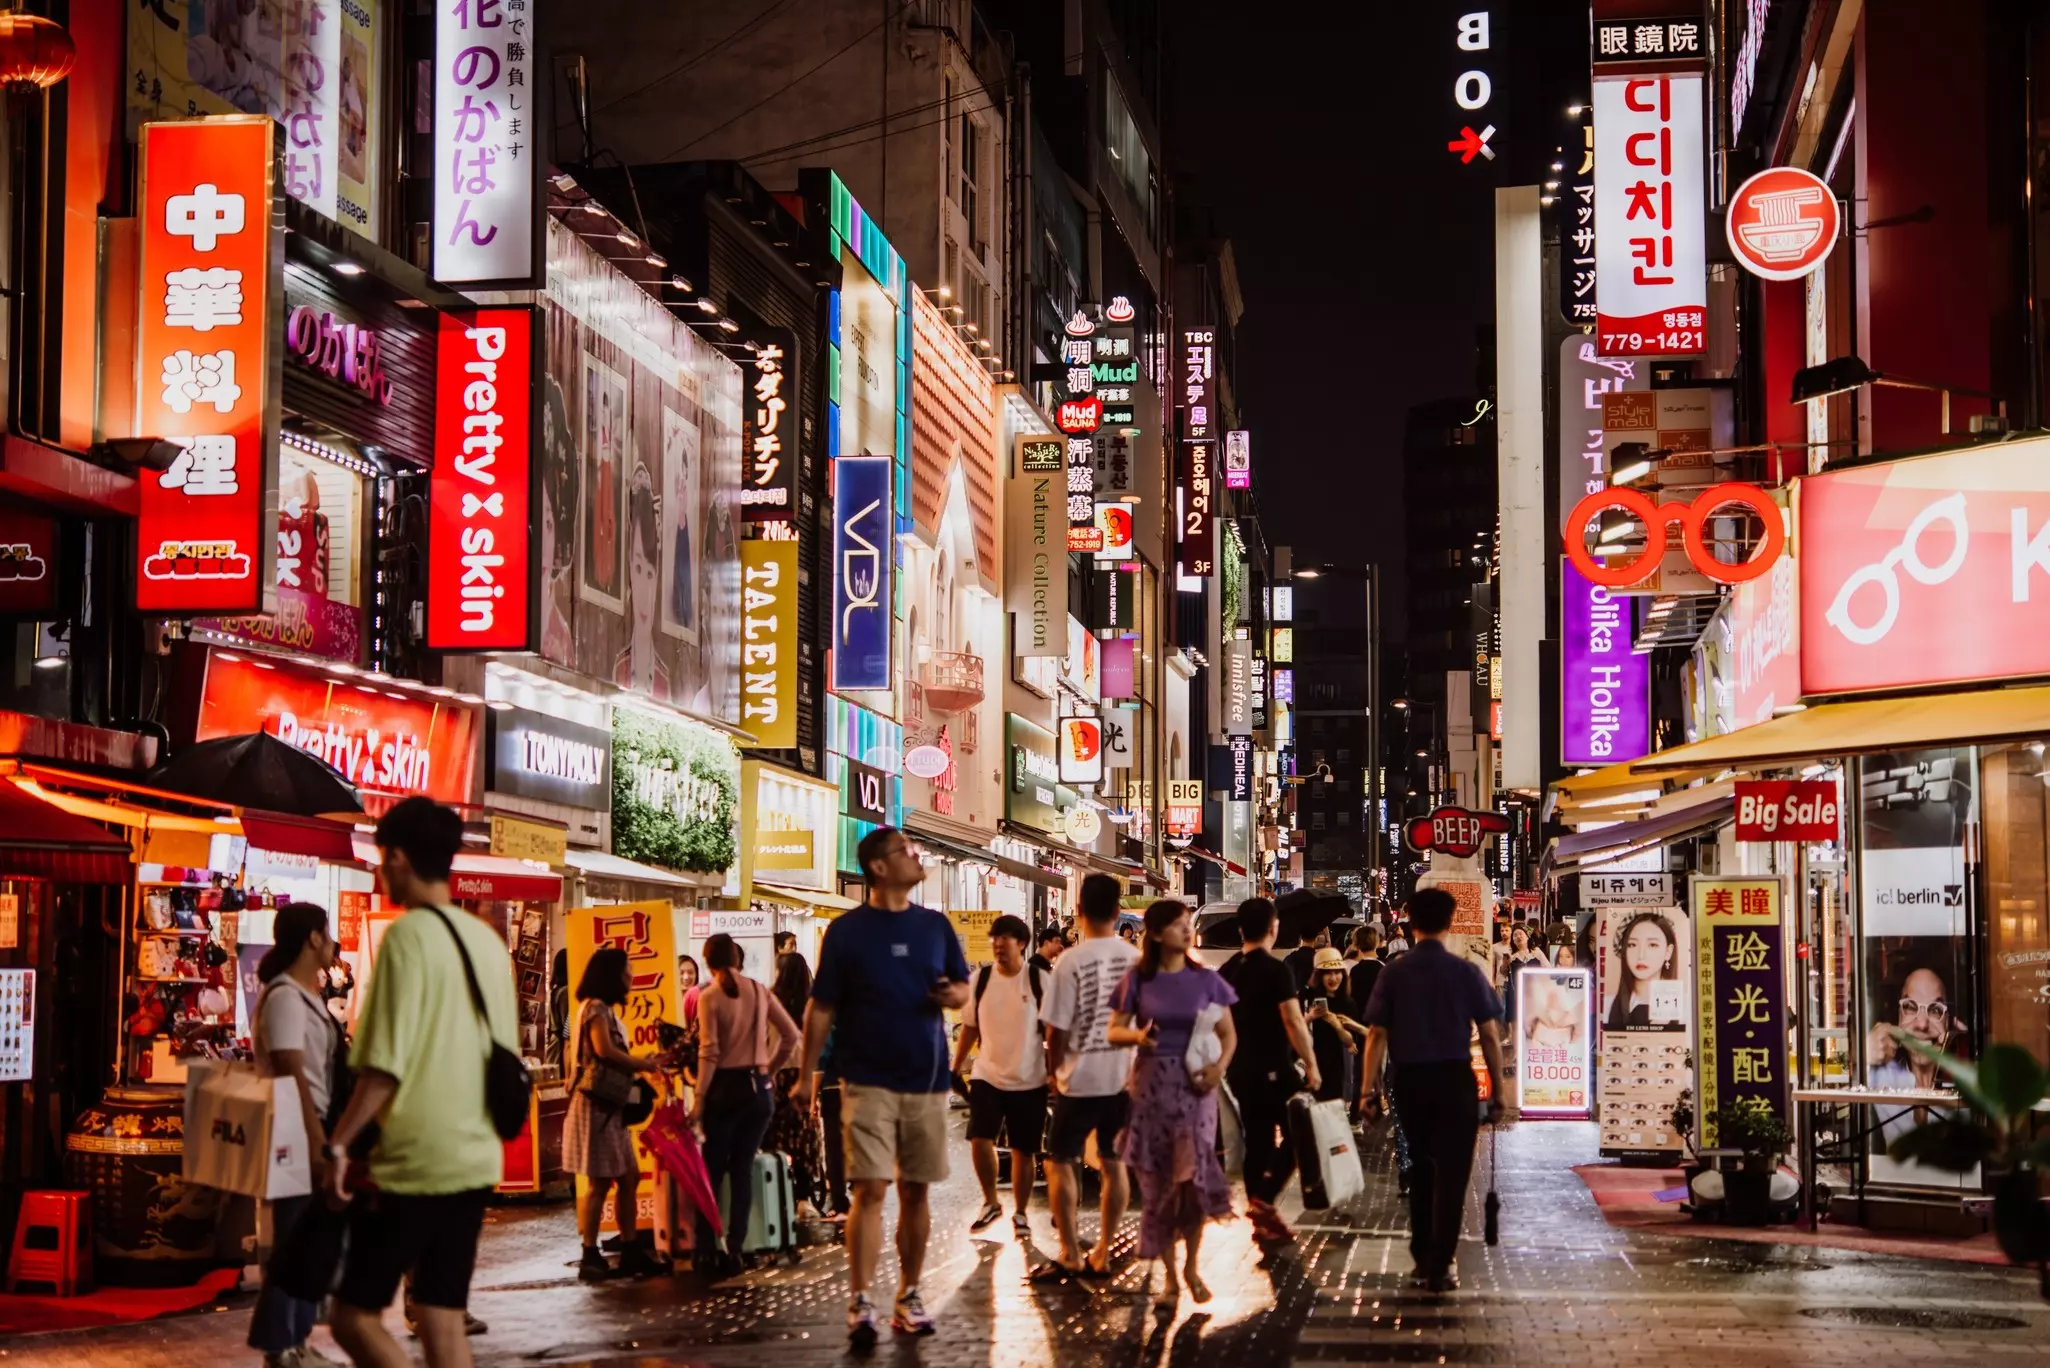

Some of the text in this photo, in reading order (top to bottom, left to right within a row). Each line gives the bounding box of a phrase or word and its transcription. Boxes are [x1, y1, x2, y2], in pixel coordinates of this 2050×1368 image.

[1600, 25, 1699, 54] 眼鏡院
[1624, 79, 1674, 285] 디디치킨
[1663, 312, 1702, 328] 명동점
[1184, 332, 1213, 343] TBC
[1603, 332, 1703, 350] 779-1421
[1090, 363, 1138, 382] Mud
[1062, 403, 1097, 419] Mud
[1062, 418, 1096, 428] SAUNA
[1608, 404, 1651, 418] style
[1608, 415, 1651, 427] mall
[1191, 426, 1206, 436] 5F
[1187, 445, 1210, 535] 준오헤어 2
[1033, 477, 1051, 649] Nature Collection
[1193, 560, 1211, 574] 3F
[460, 527, 504, 632] skin
[1590, 566, 1620, 654] olika
[743, 561, 780, 724] TALENT
[1232, 653, 1247, 723] innisfree
[1590, 664, 1621, 758] Holika
[1104, 722, 1128, 754] 光
[379, 732, 431, 791] skin
[1234, 740, 1247, 799] MEDIHEAL
[859, 772, 885, 813] VDL
[1171, 783, 1199, 798] BIG
[1171, 807, 1200, 825] MART
[1739, 794, 1836, 832] Big Sale
[1277, 825, 1289, 860] MLB
[1433, 817, 1481, 846] BEER
[1500, 832, 1509, 872] RIENDS
[1591, 877, 1664, 893] 비쥬헤어
[1897, 888, 1940, 904] berlin
[1705, 887, 1771, 916] 美瞳
[1569, 978, 1583, 988] 4F
[211, 1118, 247, 1146] FILA
